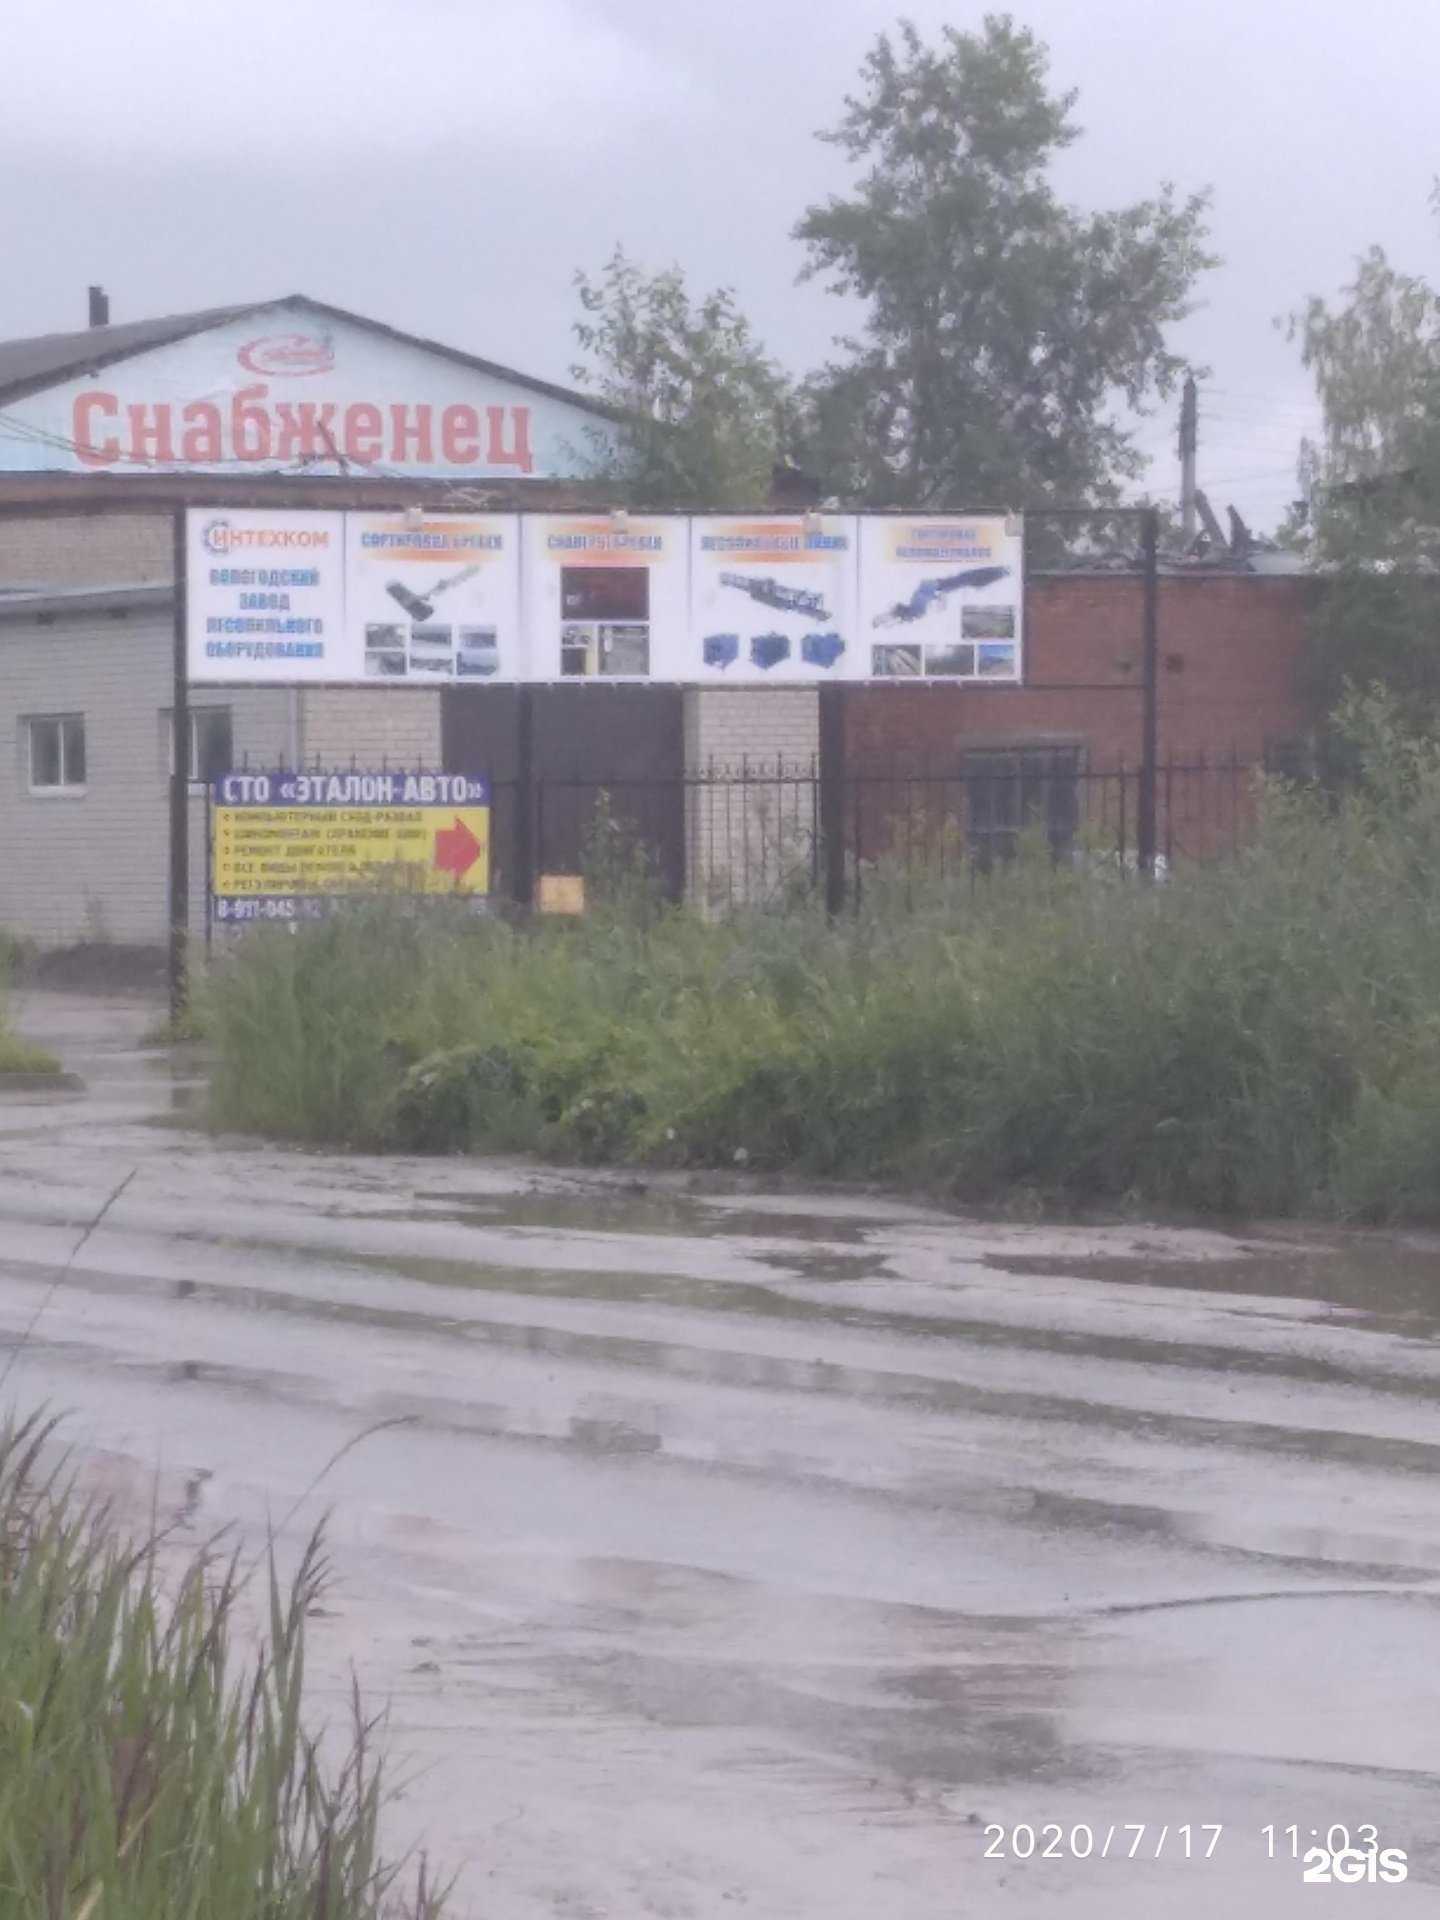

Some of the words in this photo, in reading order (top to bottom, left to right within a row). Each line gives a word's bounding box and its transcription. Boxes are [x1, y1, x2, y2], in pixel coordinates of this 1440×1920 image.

[72, 383, 536, 473] Снабженец
[239, 592, 290, 611] ЗАВОД
[224, 775, 270, 802] СТО
[279, 775, 484, 803] «ЭТАЛОН-АВТО»
